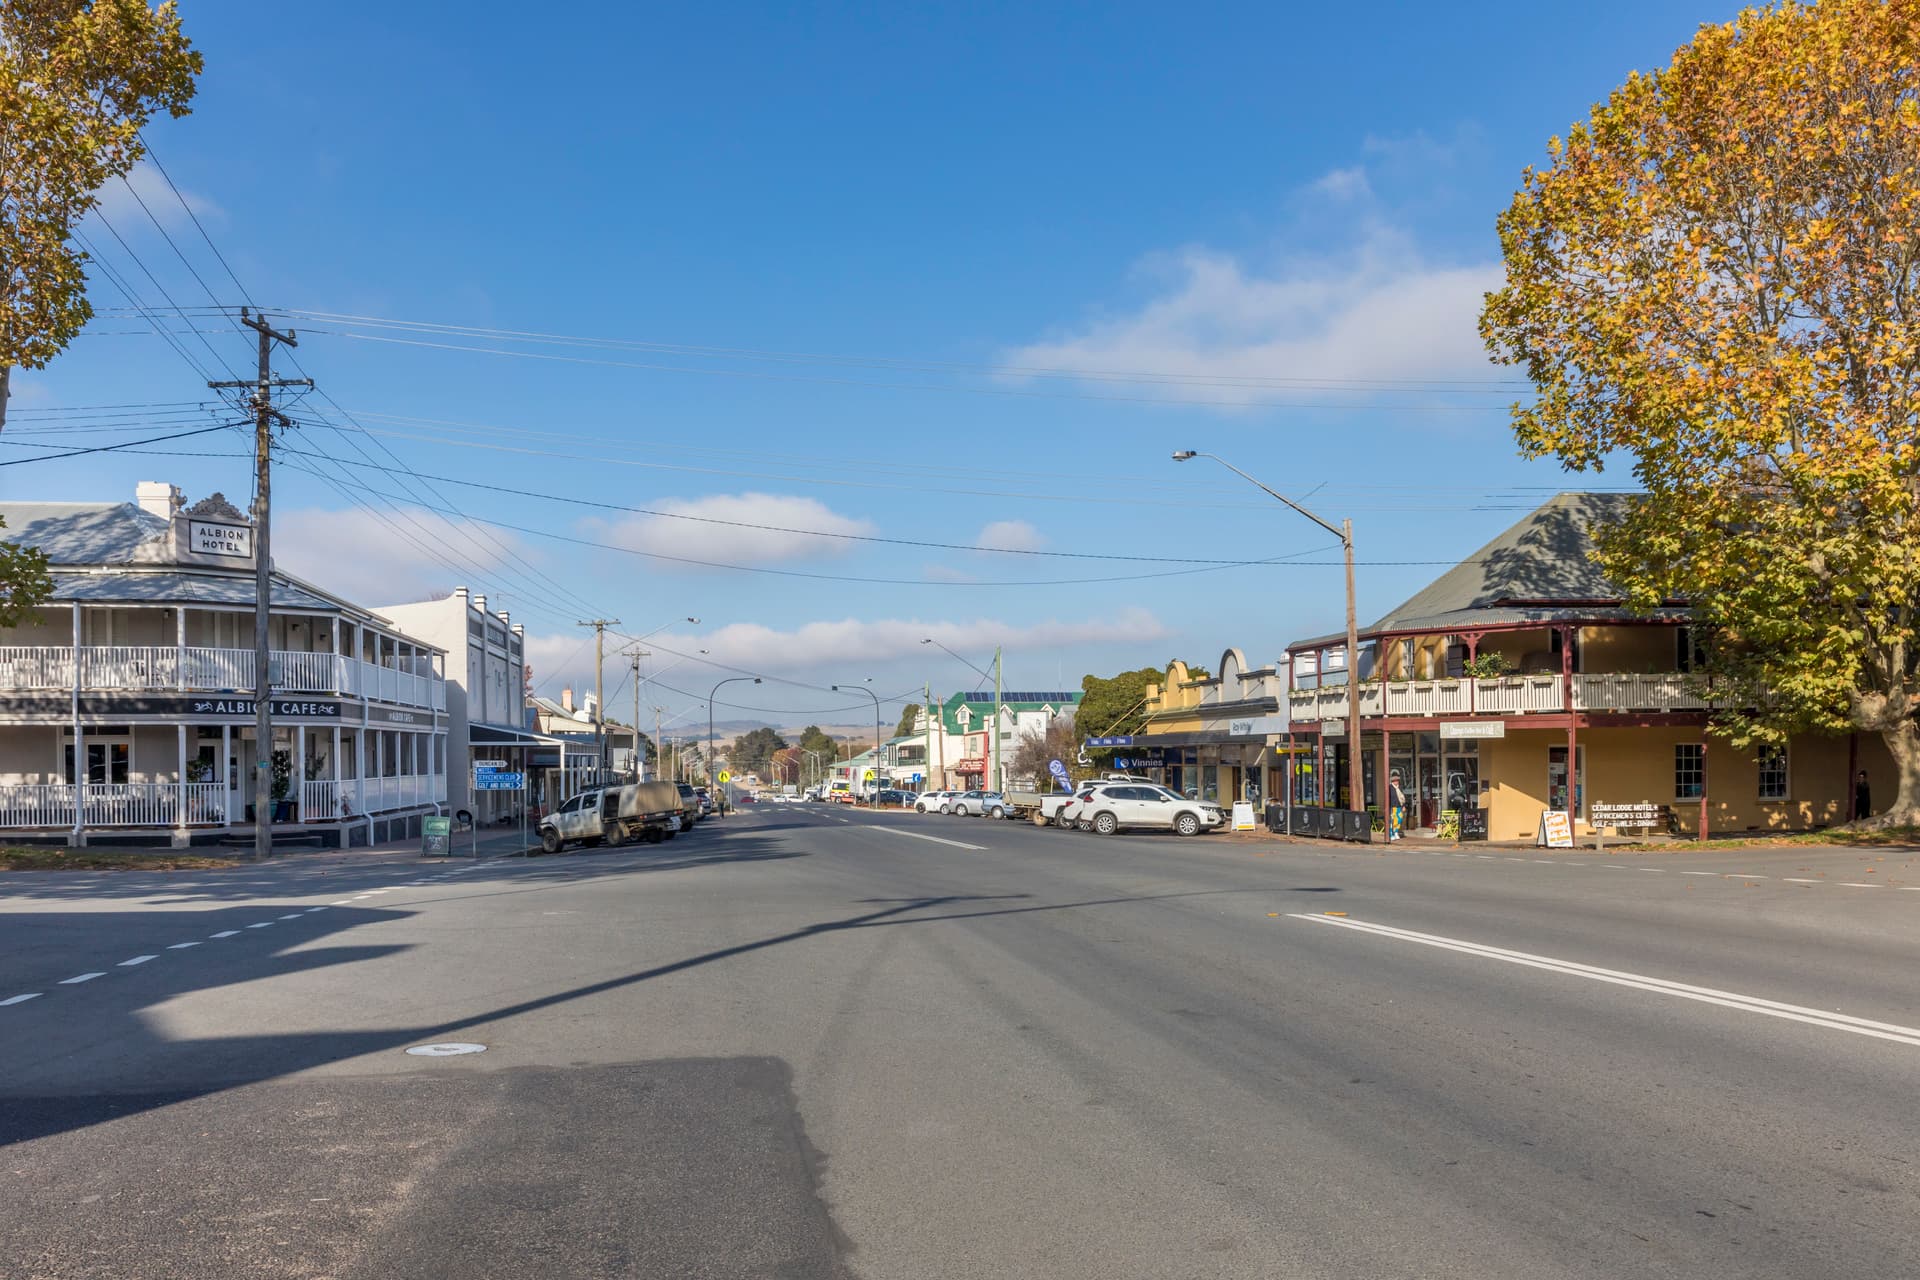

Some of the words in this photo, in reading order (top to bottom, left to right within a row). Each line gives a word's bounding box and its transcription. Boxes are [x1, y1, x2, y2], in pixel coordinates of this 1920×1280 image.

[200, 527, 243, 540] ALBION
[202, 540, 241, 551] HOTEL
[281, 703, 317, 715] CAFE
[1131, 758, 1163, 767] Vinnies
